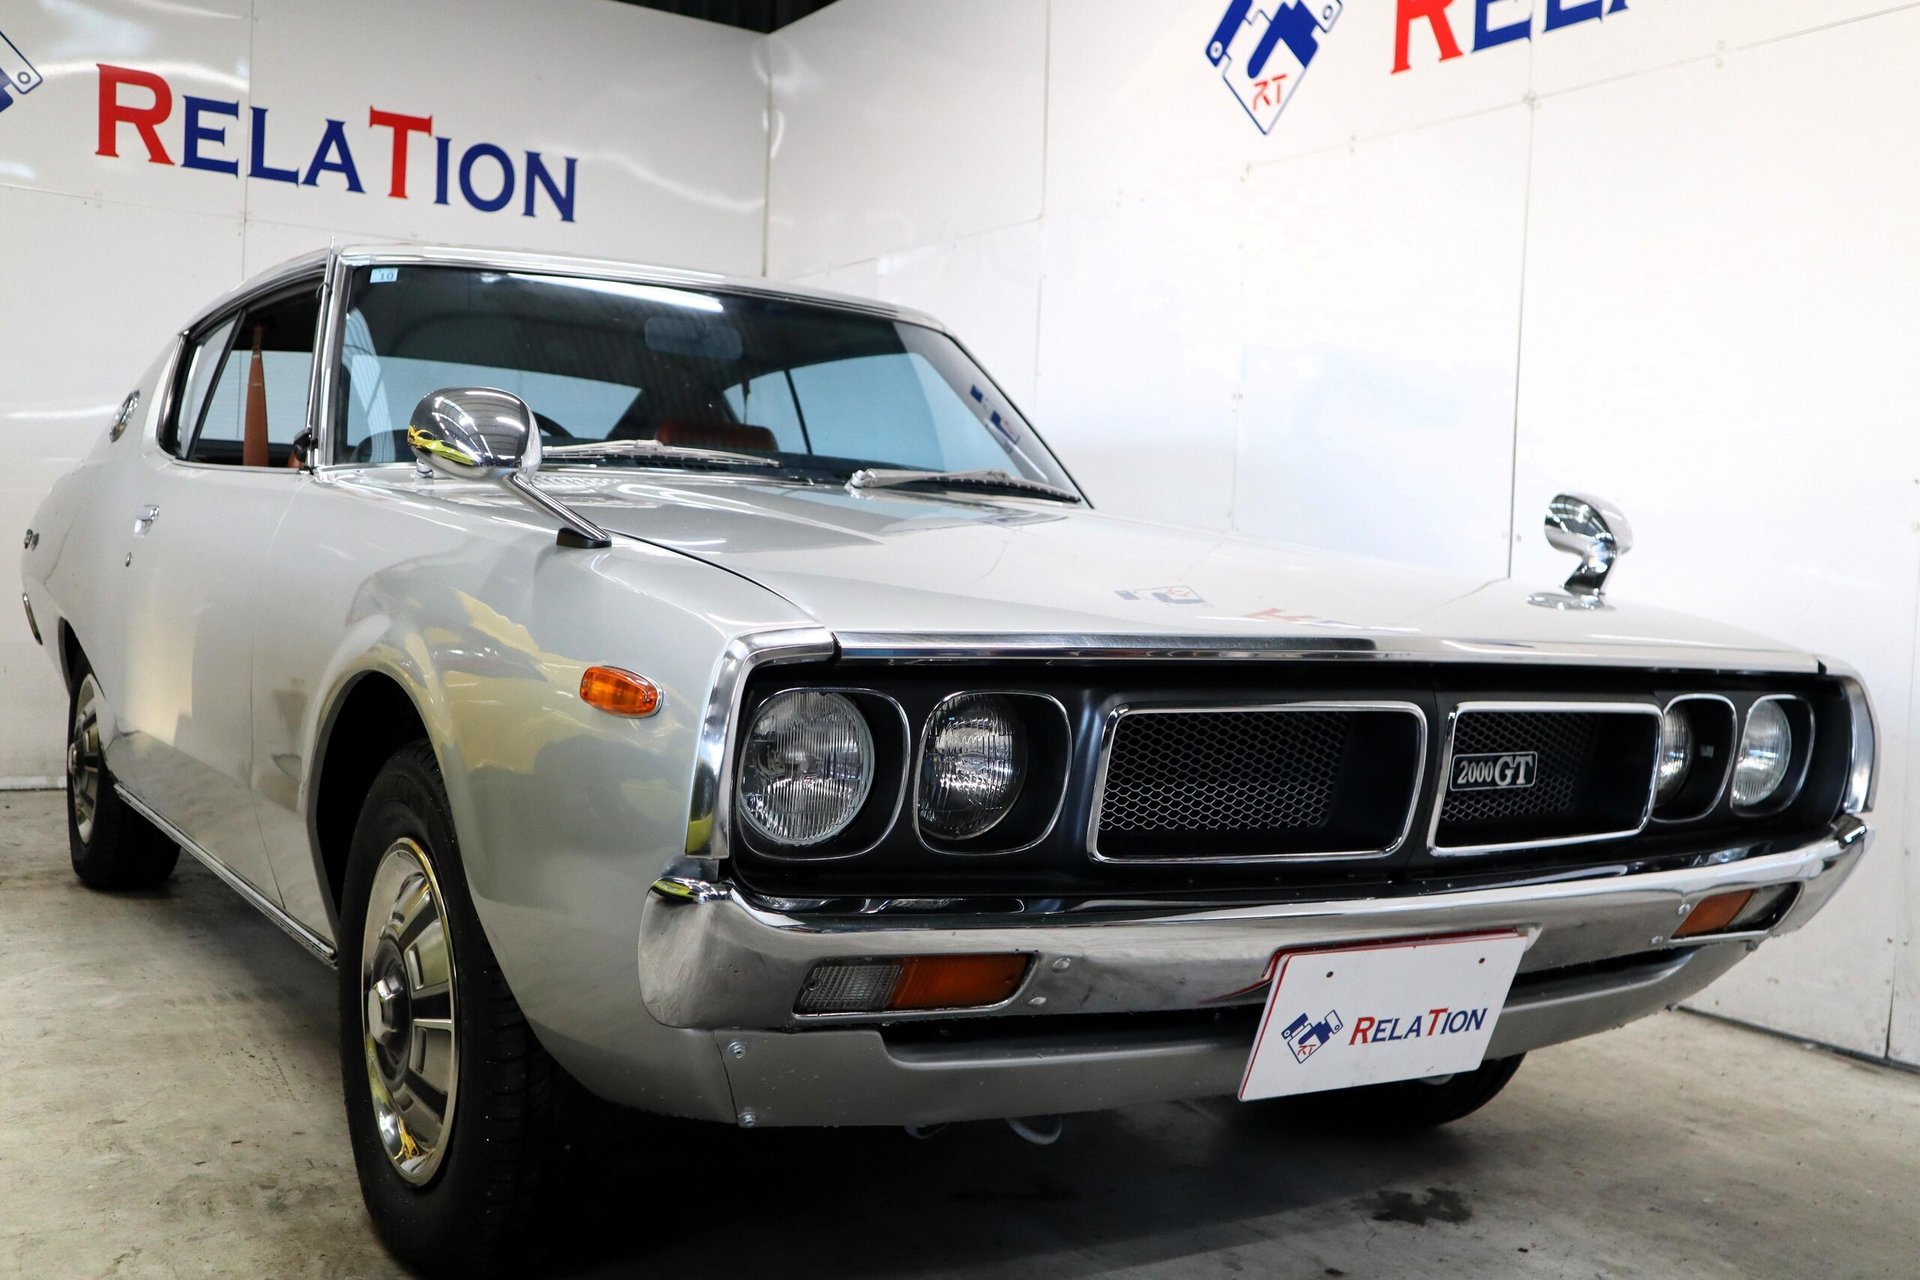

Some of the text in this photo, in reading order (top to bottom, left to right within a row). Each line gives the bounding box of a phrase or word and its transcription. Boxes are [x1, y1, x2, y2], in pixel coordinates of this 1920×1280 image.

[95, 63, 577, 223] RELATION
[1457, 755, 1533, 786] 2000GT
[1348, 1008, 1488, 1045] RELATION
